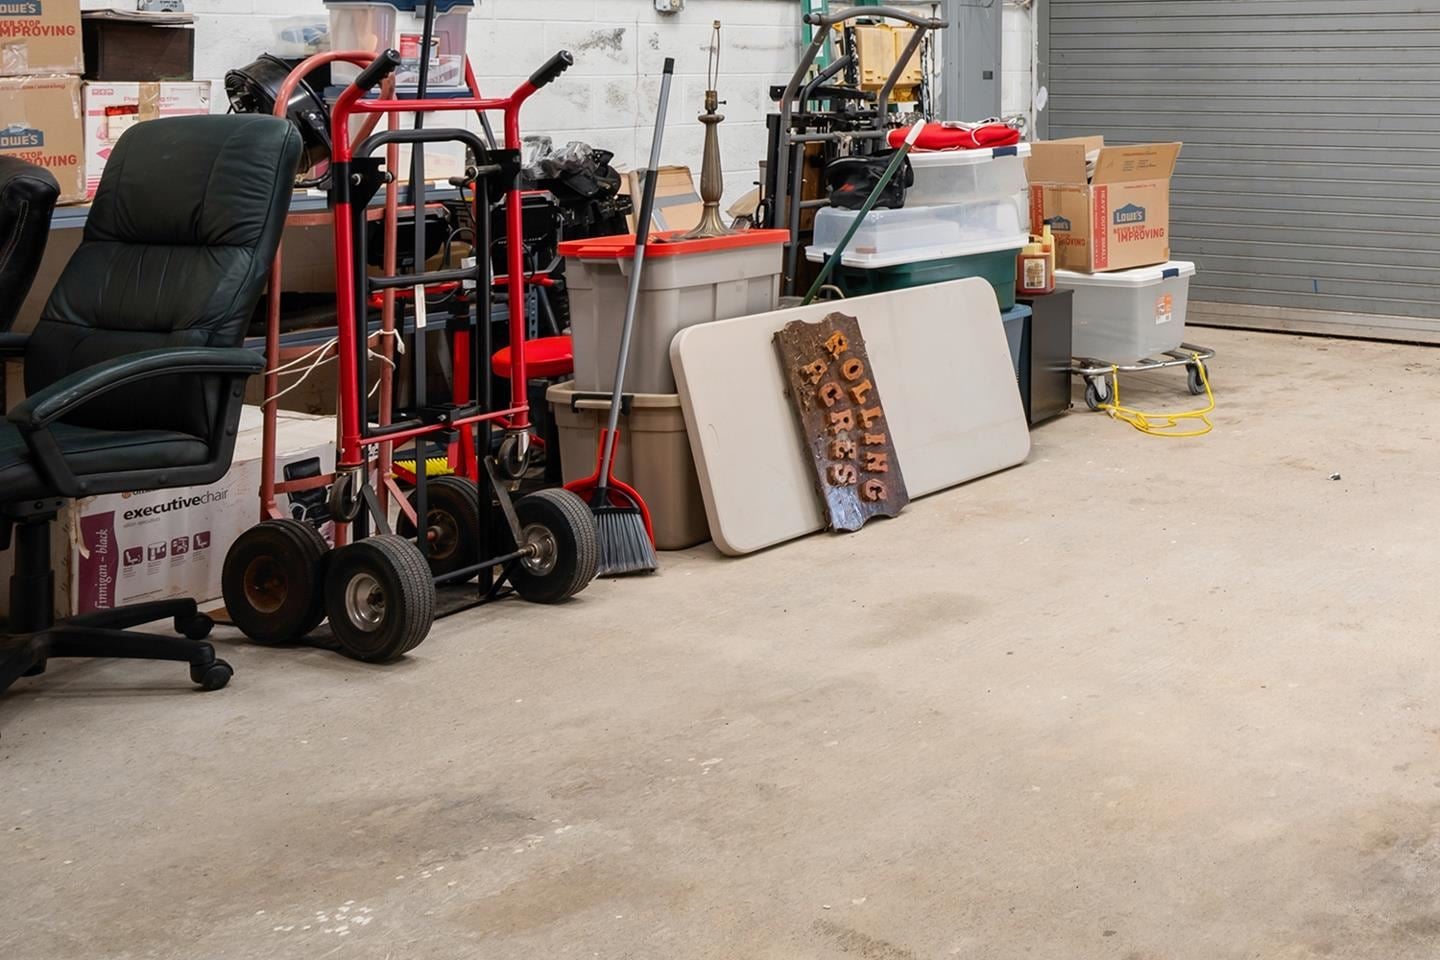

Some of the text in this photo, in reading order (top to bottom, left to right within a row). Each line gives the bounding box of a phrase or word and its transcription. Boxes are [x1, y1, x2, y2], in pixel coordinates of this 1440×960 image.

[0, 3, 37, 14] OWE'S
[0, 25, 76, 37] MPROVING
[0, 134, 39, 146] OWE'S
[19, 151, 43, 159] STOP
[1117, 228, 1165, 243] IMPROVING
[797, 358, 858, 488] ACRES
[824, 331, 889, 502] ROLLING
[95, 528, 109, 554] black
